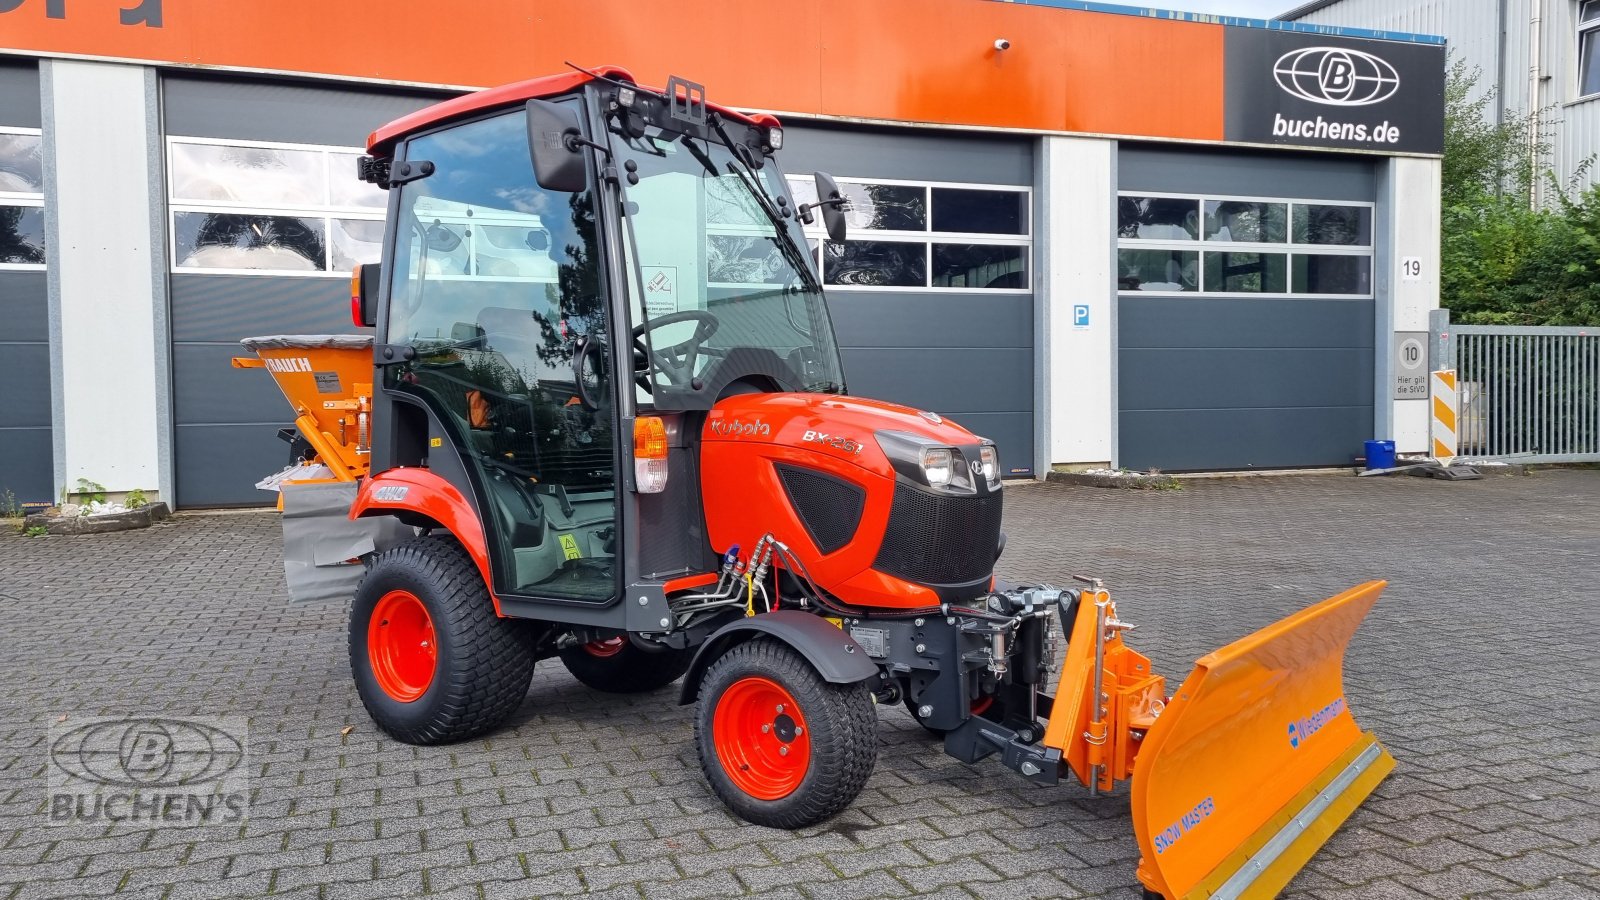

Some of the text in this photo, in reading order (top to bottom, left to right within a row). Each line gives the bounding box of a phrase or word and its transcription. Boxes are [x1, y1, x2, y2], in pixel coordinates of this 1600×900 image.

[1272, 113, 1400, 143] buchens.de
[1403, 260, 1421, 276] 19
[1075, 306, 1088, 324] P
[1405, 346, 1418, 361] 10
[268, 357, 312, 372] RAUCH
[1397, 376, 1425, 385] Hier gilt
[1397, 385, 1426, 394] die StVO
[711, 418, 771, 436] Kubota
[375, 486, 409, 501] 4WD
[1297, 697, 1345, 741] Wiedenmann
[1154, 797, 1215, 854] SNOW MASTER
